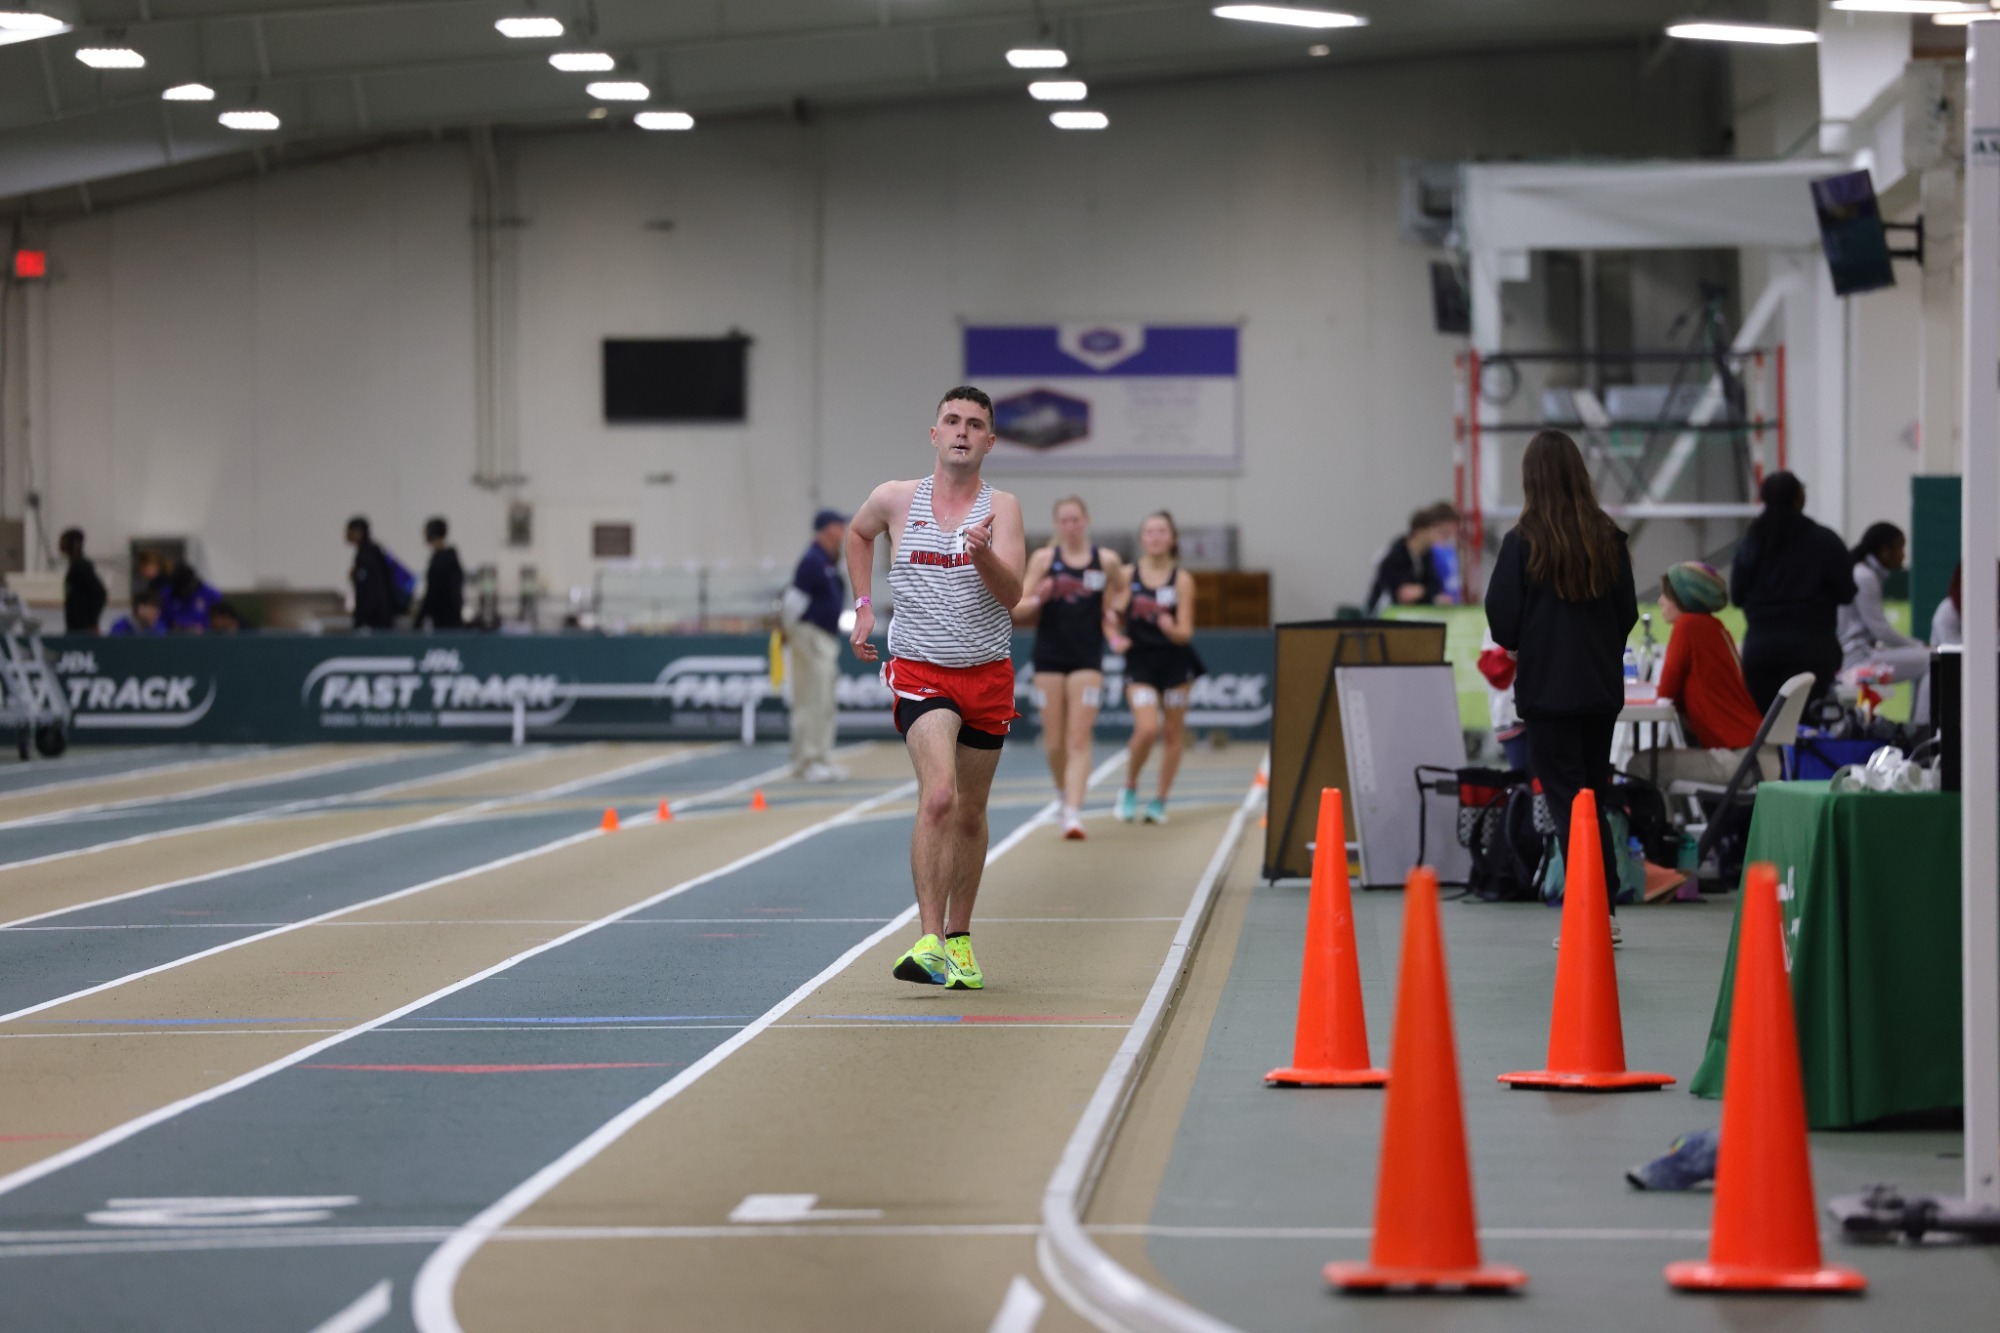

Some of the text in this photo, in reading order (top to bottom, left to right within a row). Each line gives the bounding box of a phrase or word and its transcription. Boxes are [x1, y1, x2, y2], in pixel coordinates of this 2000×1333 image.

[66, 676, 195, 709] TRACK
[320, 674, 558, 708] FAST TRACK
[1190, 672, 1267, 707] ACK
